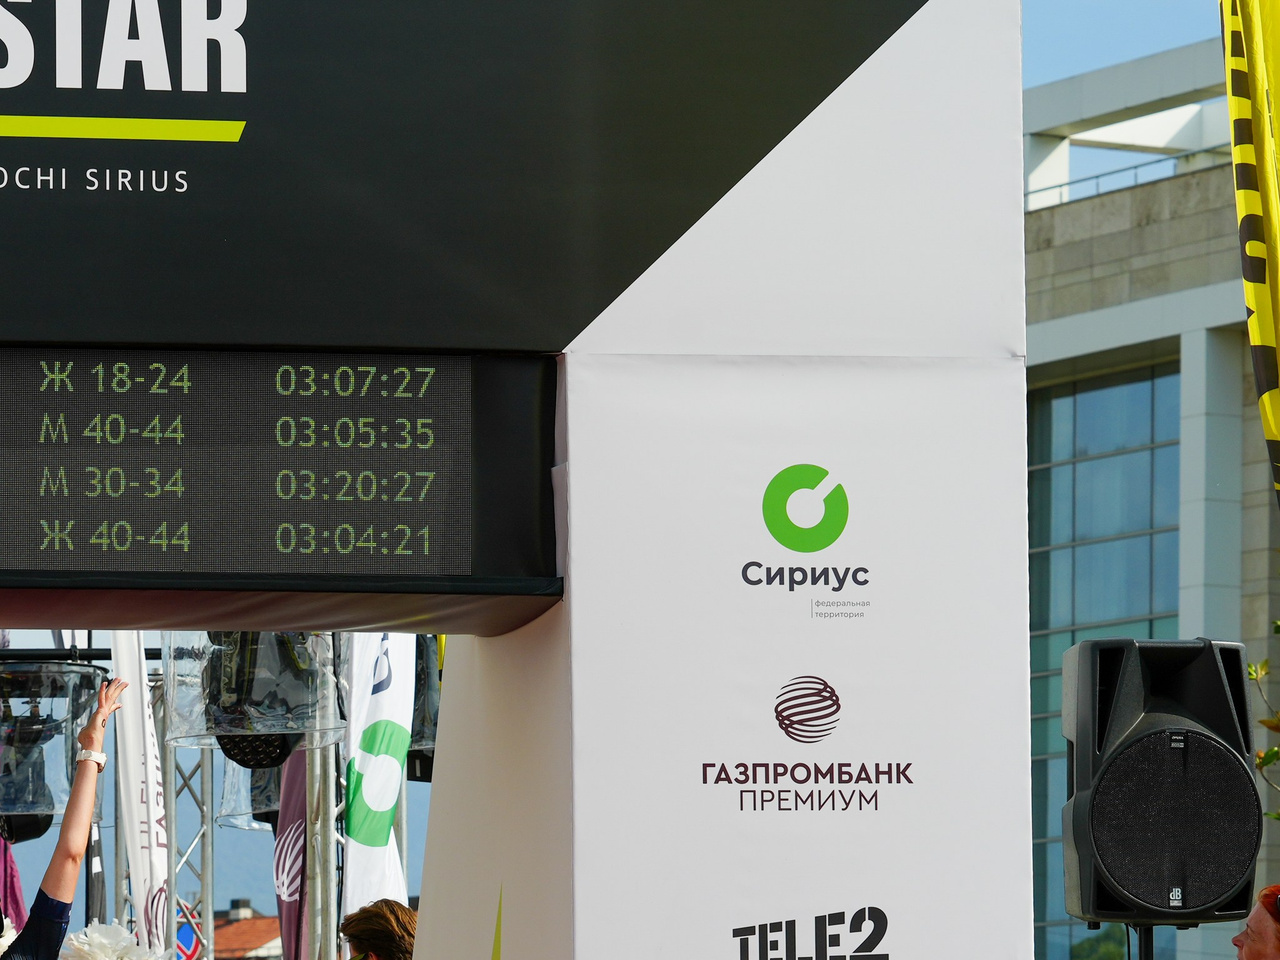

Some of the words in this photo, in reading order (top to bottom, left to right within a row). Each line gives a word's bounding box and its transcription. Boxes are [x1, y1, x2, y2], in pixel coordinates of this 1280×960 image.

[86, 168, 189, 193] SIRIUS
[39, 361, 74, 392] Ж
[91, 361, 192, 395] 18-24
[275, 364, 436, 398] 03:07:27
[39, 412, 69, 444] М
[82, 412, 186, 445] 40-44
[275, 416, 435, 448] 03:05:35
[39, 466, 69, 497] М
[84, 466, 186, 498] 30-34
[275, 469, 436, 501] 03:20:27
[39, 519, 74, 551] Ж
[89, 519, 191, 552] 40-44
[275, 522, 431, 555] 03:04:21
[741, 561, 870, 592] Сириус
[814, 599, 871, 609] федеральная
[814, 611, 865, 620] территория
[702, 762, 913, 785] ГАЗПРОМБАНК
[739, 789, 879, 811] ПРЕМИУМ
